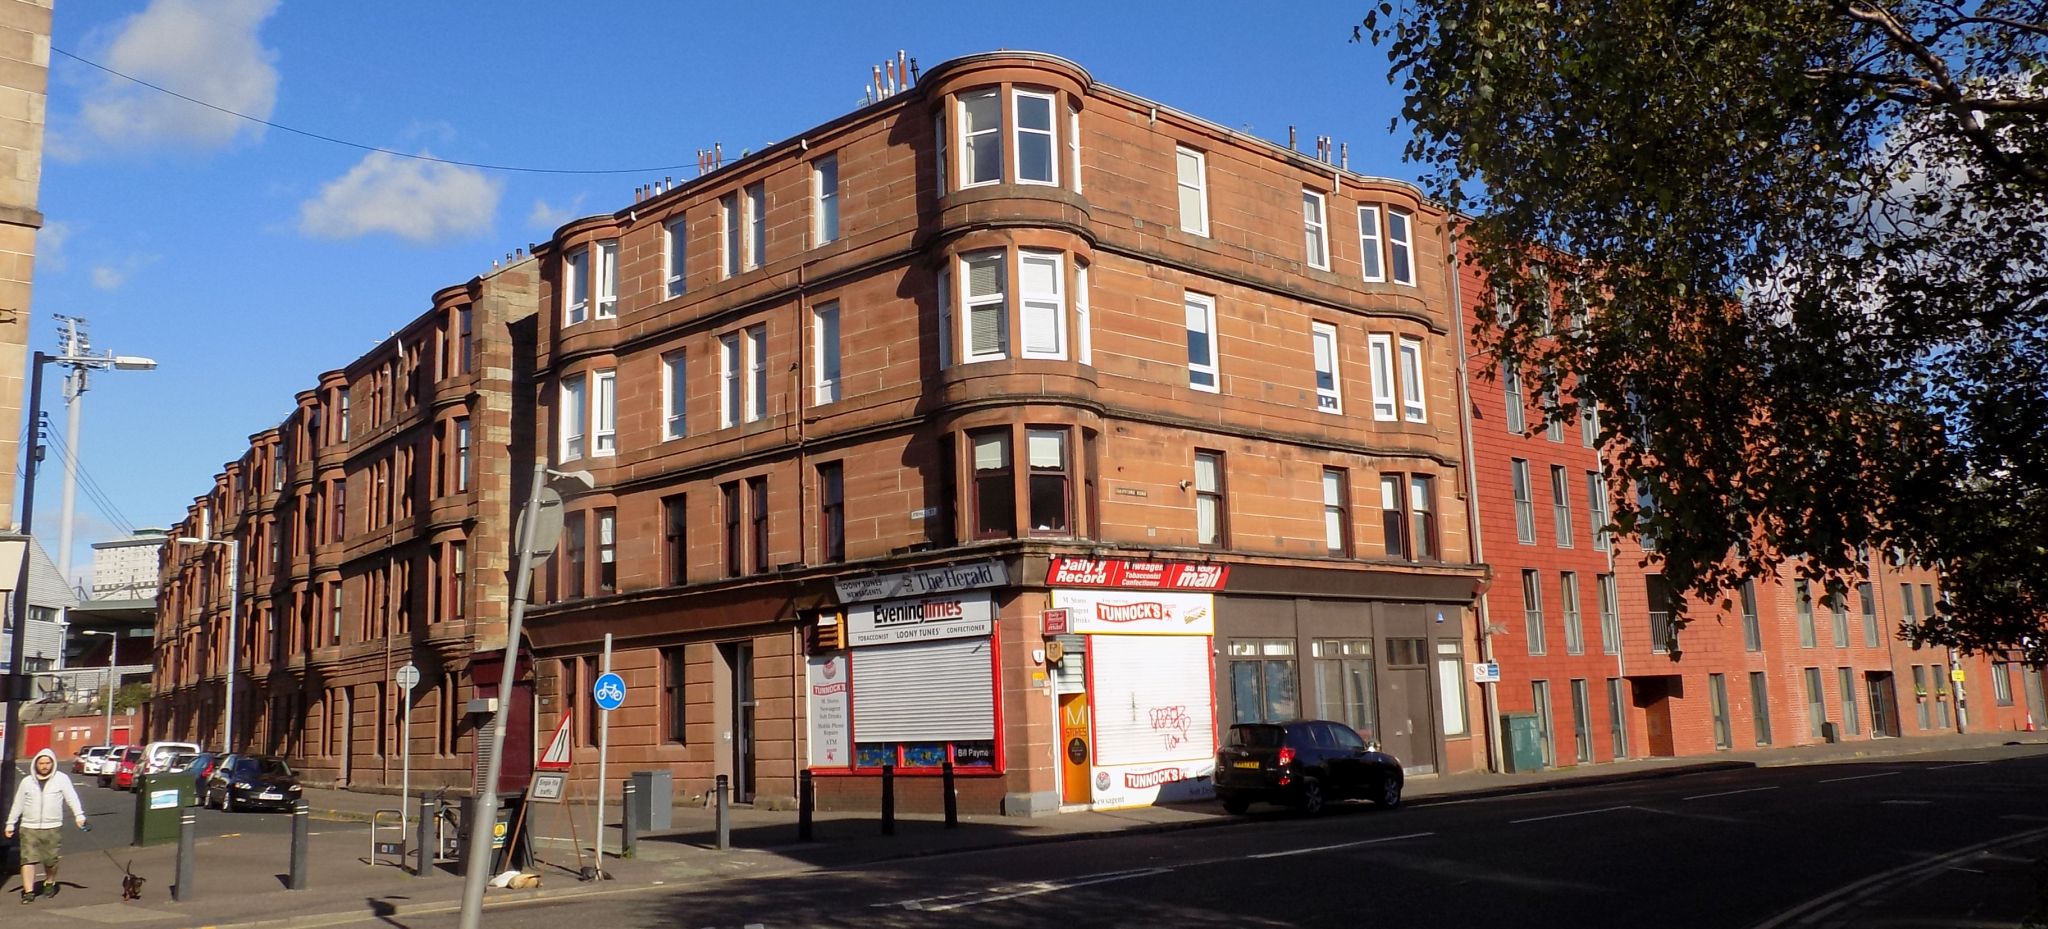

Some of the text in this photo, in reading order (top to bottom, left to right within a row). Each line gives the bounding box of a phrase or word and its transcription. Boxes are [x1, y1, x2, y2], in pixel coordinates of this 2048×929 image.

[916, 565, 994, 590] The Herald
[1056, 570, 1106, 583] Record
[1122, 579, 1160, 587] Confectioner
[1125, 571, 1161, 579] Tobacconist
[1176, 566, 1221, 587] mail
[841, 579, 882, 590] LOONY TUNES
[1099, 603, 1161, 621] TUNNOCK'S
[857, 633, 889, 641] TOBACCONIST
[947, 624, 985, 634] CONFECTIONER
[1066, 705, 1085, 727] M
[957, 748, 967, 757] Bill
[1126, 768, 1179, 788] TUNNOCK'S
